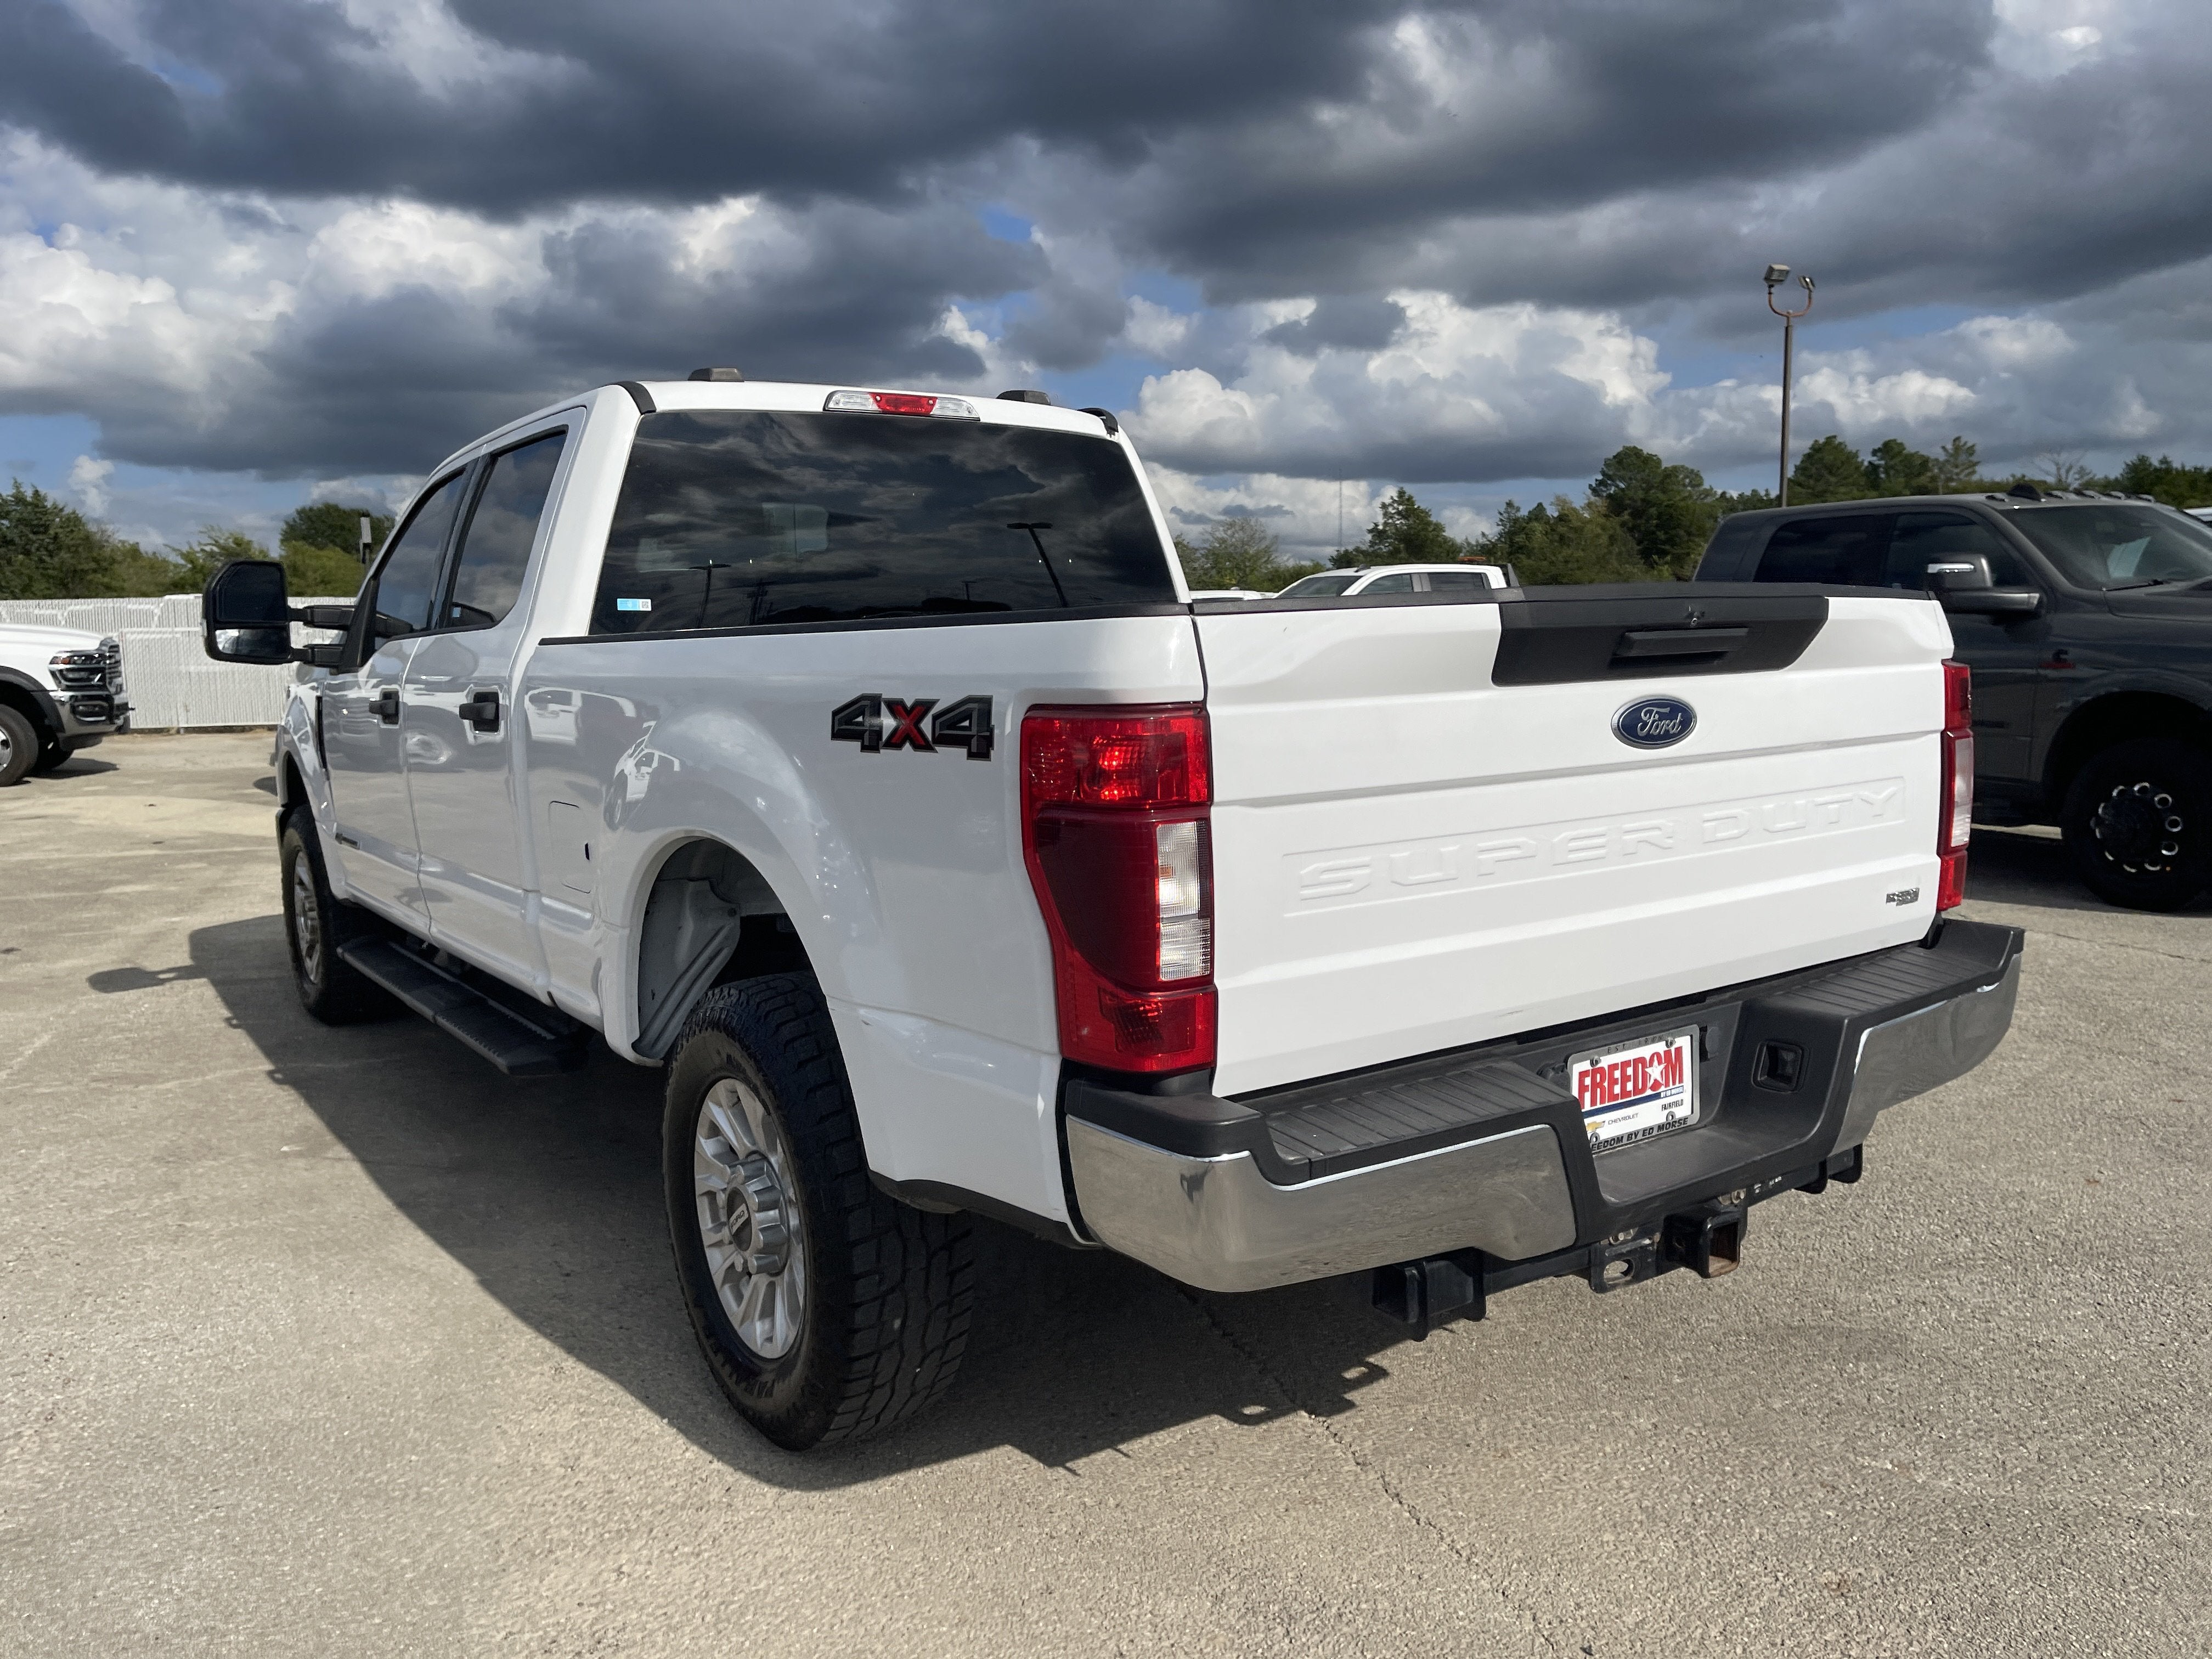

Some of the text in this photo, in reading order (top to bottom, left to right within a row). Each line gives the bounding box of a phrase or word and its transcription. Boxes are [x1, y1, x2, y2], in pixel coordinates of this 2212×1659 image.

[831, 693, 995, 761] 4X4
[1638, 707, 1683, 736] Ford
[1300, 787, 1898, 901] SUPER DUTY
[1578, 1046, 1684, 1109] FREEDOM
[1608, 1113, 1639, 1125] CHEVROLET
[1662, 1099, 1684, 1111] FAIRFIELD
[1627, 1132, 1639, 1142] BY
[1642, 1127, 1654, 1137] ED
[1657, 1117, 1689, 1133] MORSE
